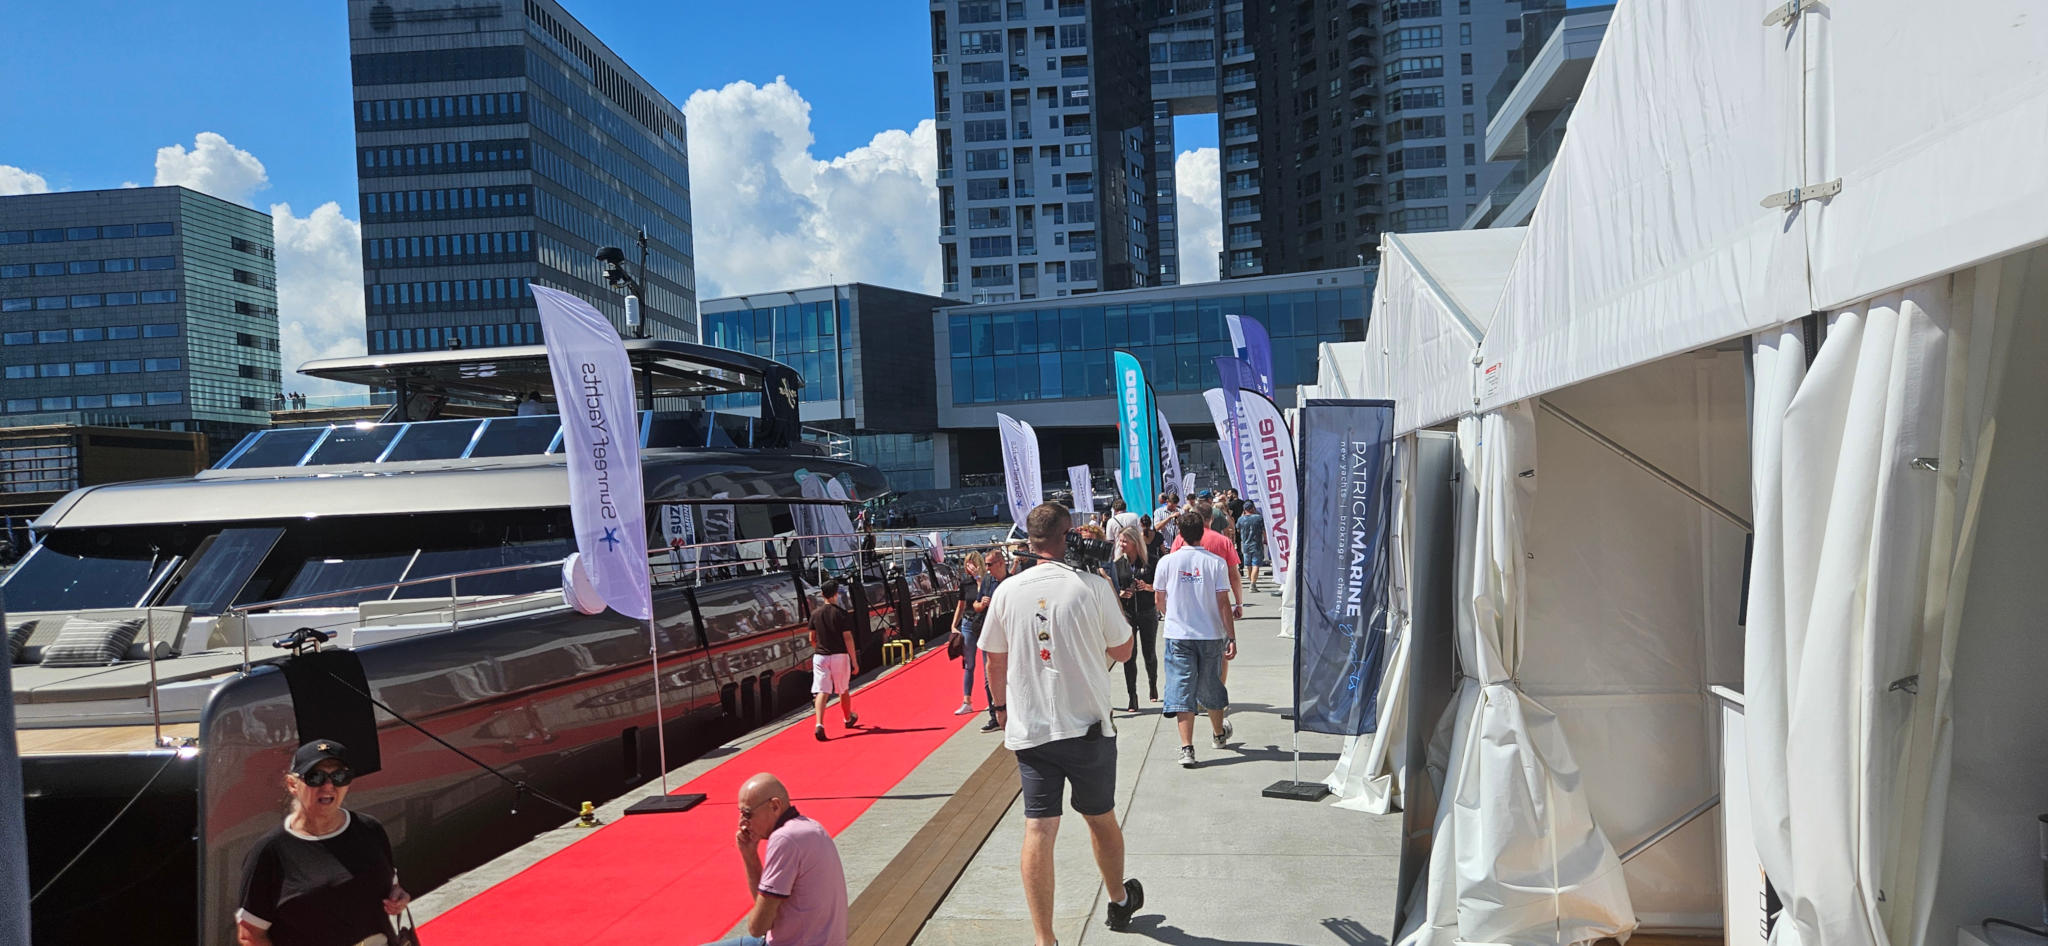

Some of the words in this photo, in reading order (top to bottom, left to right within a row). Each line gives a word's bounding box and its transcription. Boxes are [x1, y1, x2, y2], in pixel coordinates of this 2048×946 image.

[1339, 464, 1348, 498] yachts
[669, 504, 682, 535] SUZ
[1337, 515, 1347, 560] brokrage
[1346, 441, 1367, 617] PATRICKMARINE
[1335, 577, 1344, 615] charter
